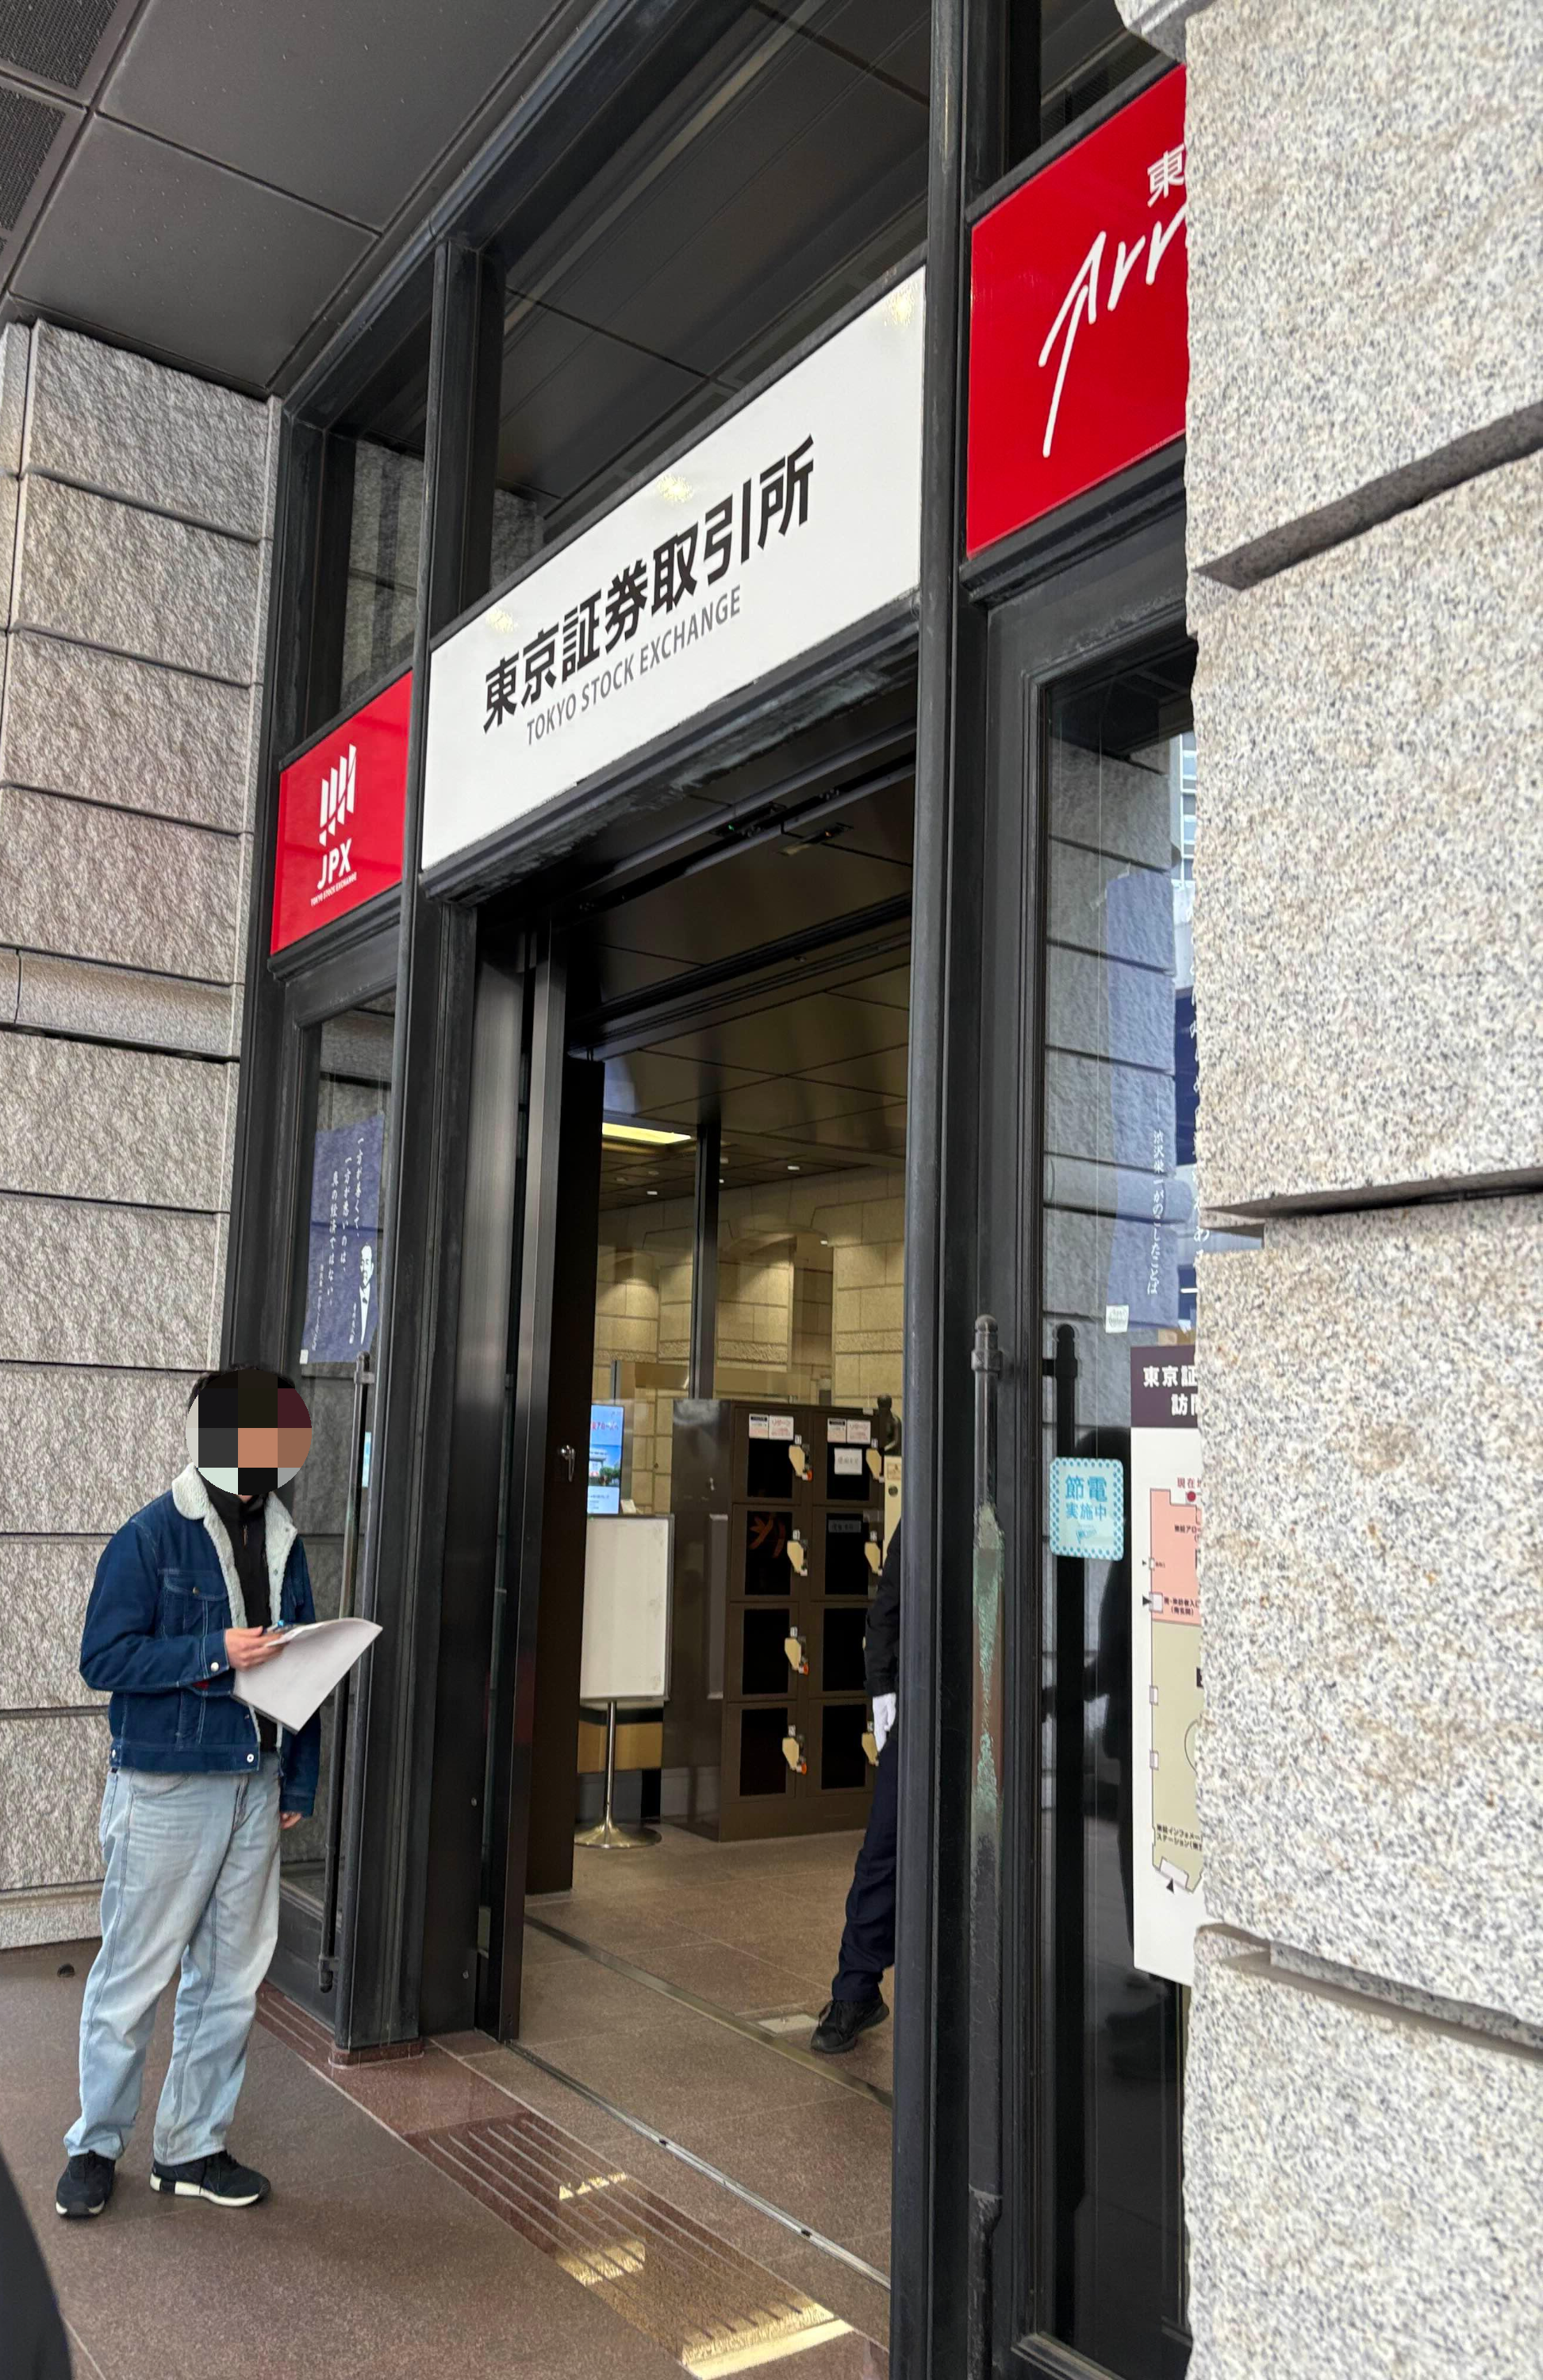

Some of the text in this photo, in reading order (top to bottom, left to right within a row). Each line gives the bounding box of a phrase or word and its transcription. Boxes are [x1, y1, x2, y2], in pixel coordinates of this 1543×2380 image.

[1147, 143, 1185, 208] 東
[483, 434, 814, 734] 東京証券取引所
[527, 585, 741, 746] TOKYO STOCK EXCHANGE
[317, 838, 352, 890] JPX
[1065, 1475, 1107, 1502] 節電
[1065, 1502, 1107, 1522] 実施中
